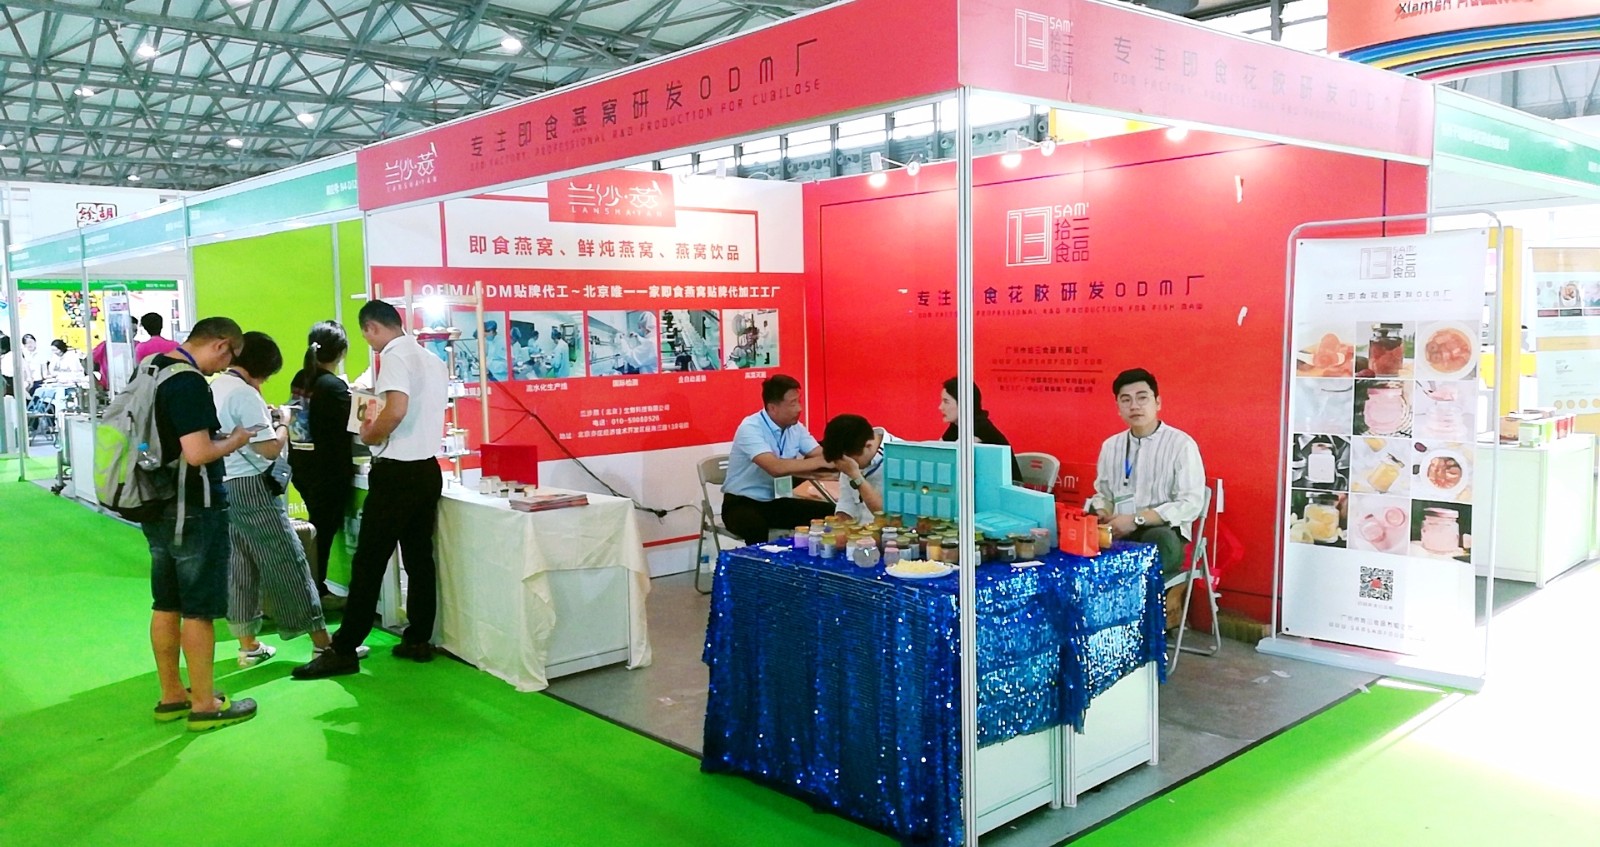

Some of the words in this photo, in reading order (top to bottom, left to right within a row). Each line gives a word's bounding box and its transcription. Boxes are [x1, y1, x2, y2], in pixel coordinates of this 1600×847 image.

[639, 107, 713, 133] PRODUCTION
[720, 98, 743, 112] FOR
[752, 78, 821, 106] CUBILOSE
[469, 235, 740, 261] 即食燕窝、鲜炖燕窝、燕窝饮品
[1055, 241, 1089, 263] 食品
[917, 275, 1204, 307] 专注食花胶研发ODM厂
